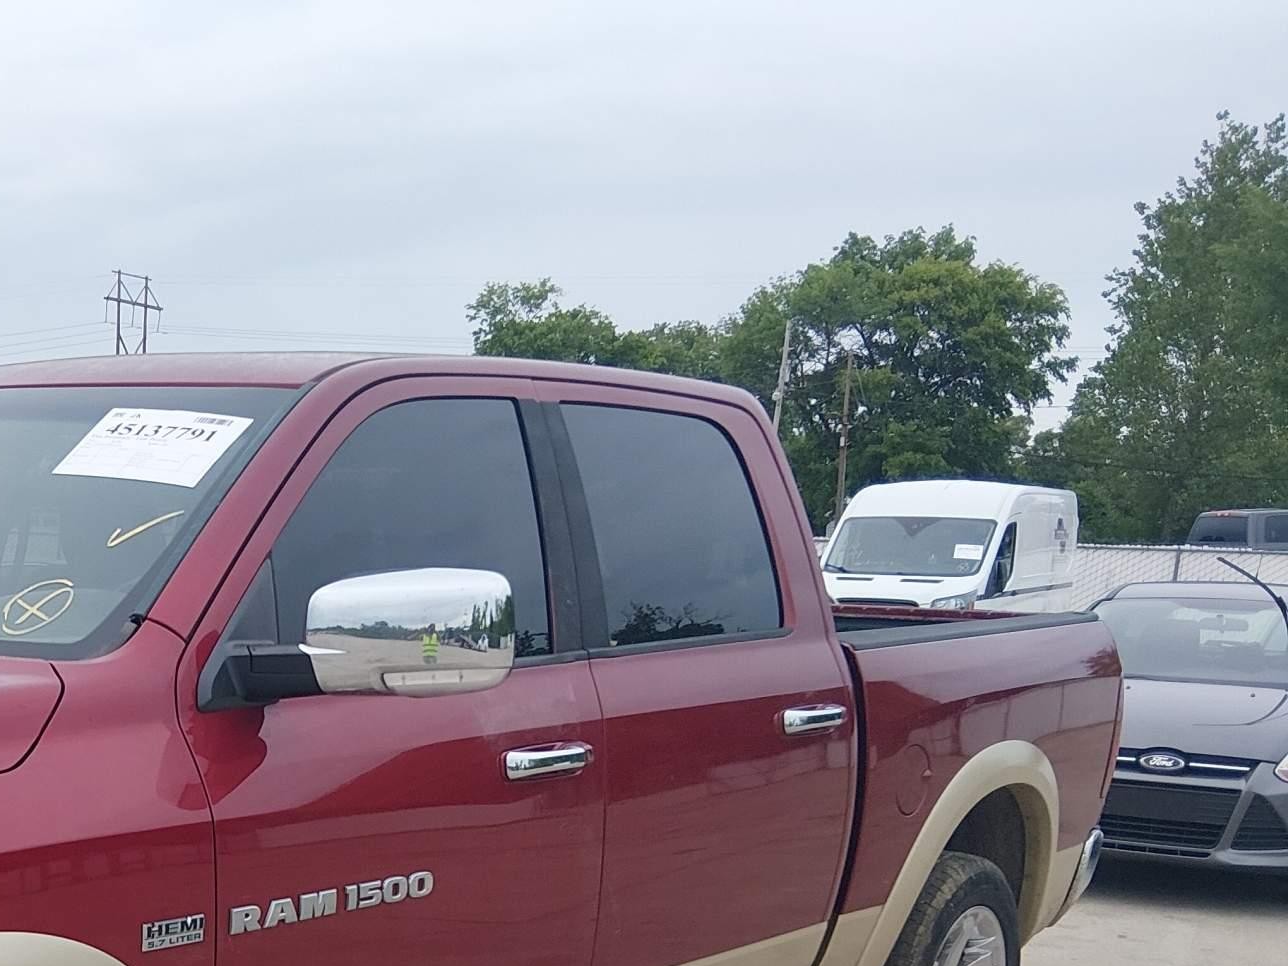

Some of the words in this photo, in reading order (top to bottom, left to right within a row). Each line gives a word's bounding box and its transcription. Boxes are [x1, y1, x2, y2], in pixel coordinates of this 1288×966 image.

[106, 422, 217, 442] 45137791
[230, 888, 337, 935] RAM
[344, 871, 434, 912] 1500
[146, 917, 204, 939] HEMI
[147, 940, 166, 949] 5.7
[169, 932, 201, 945] LITER
